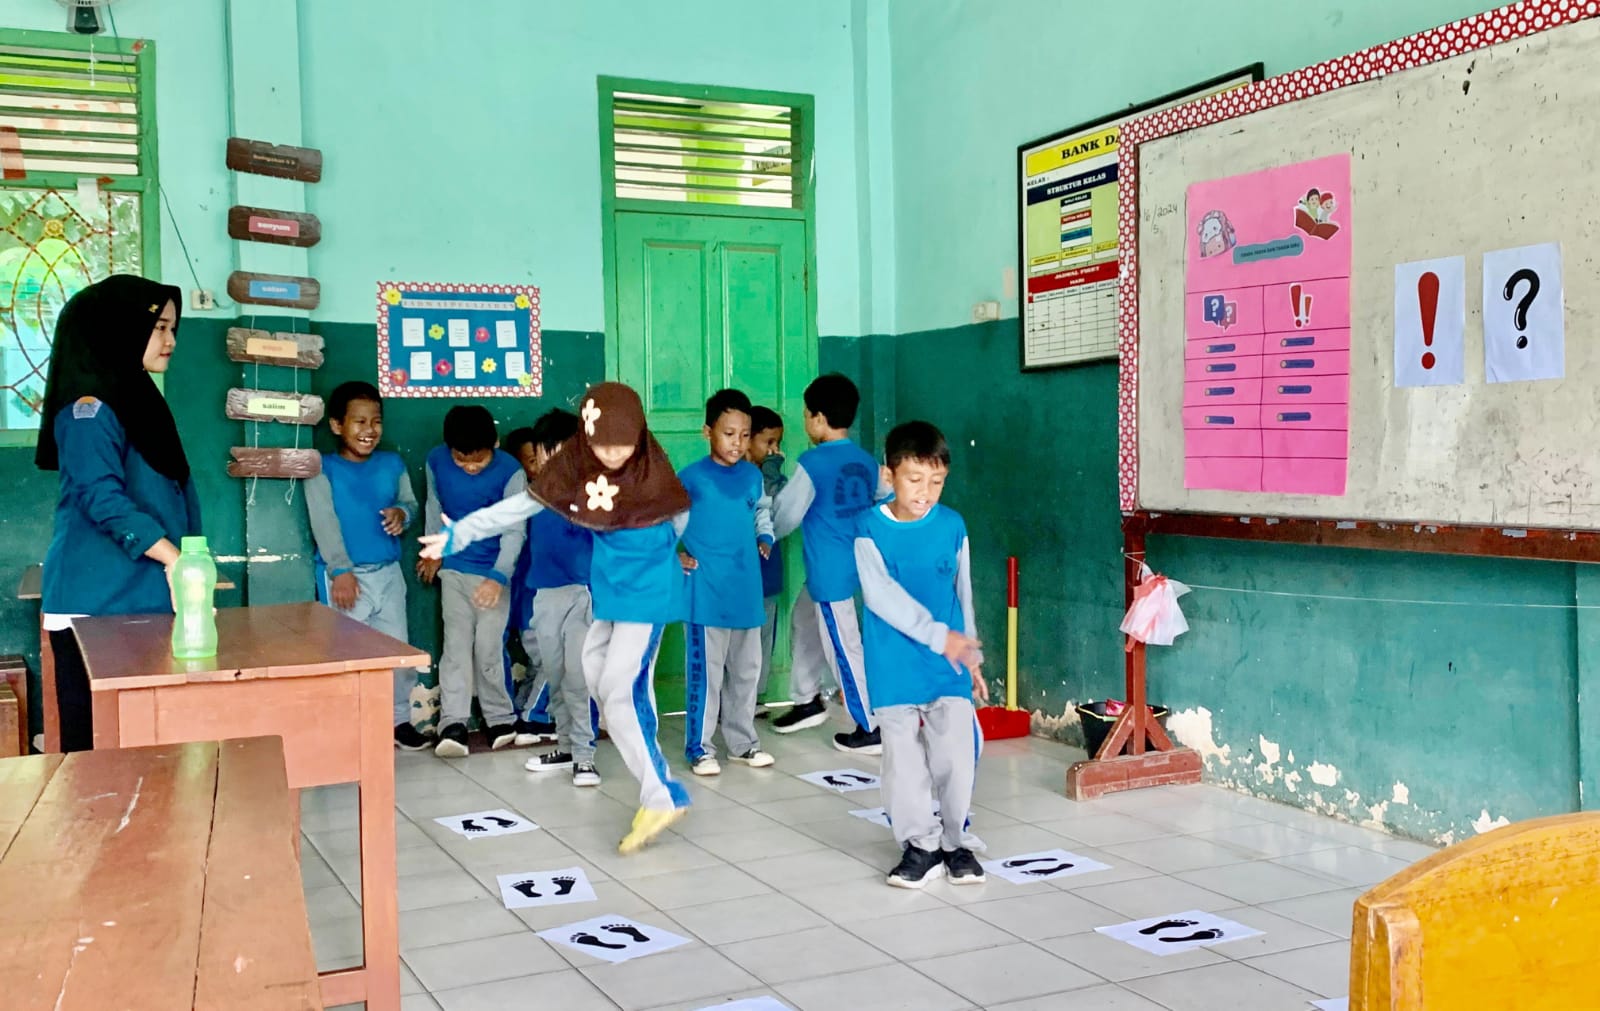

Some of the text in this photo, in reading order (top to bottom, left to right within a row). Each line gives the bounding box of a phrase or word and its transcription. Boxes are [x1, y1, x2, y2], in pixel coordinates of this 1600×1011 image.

[1062, 139, 1100, 159] BANK
[1047, 172, 1107, 195] STRUKTUR KELAS
